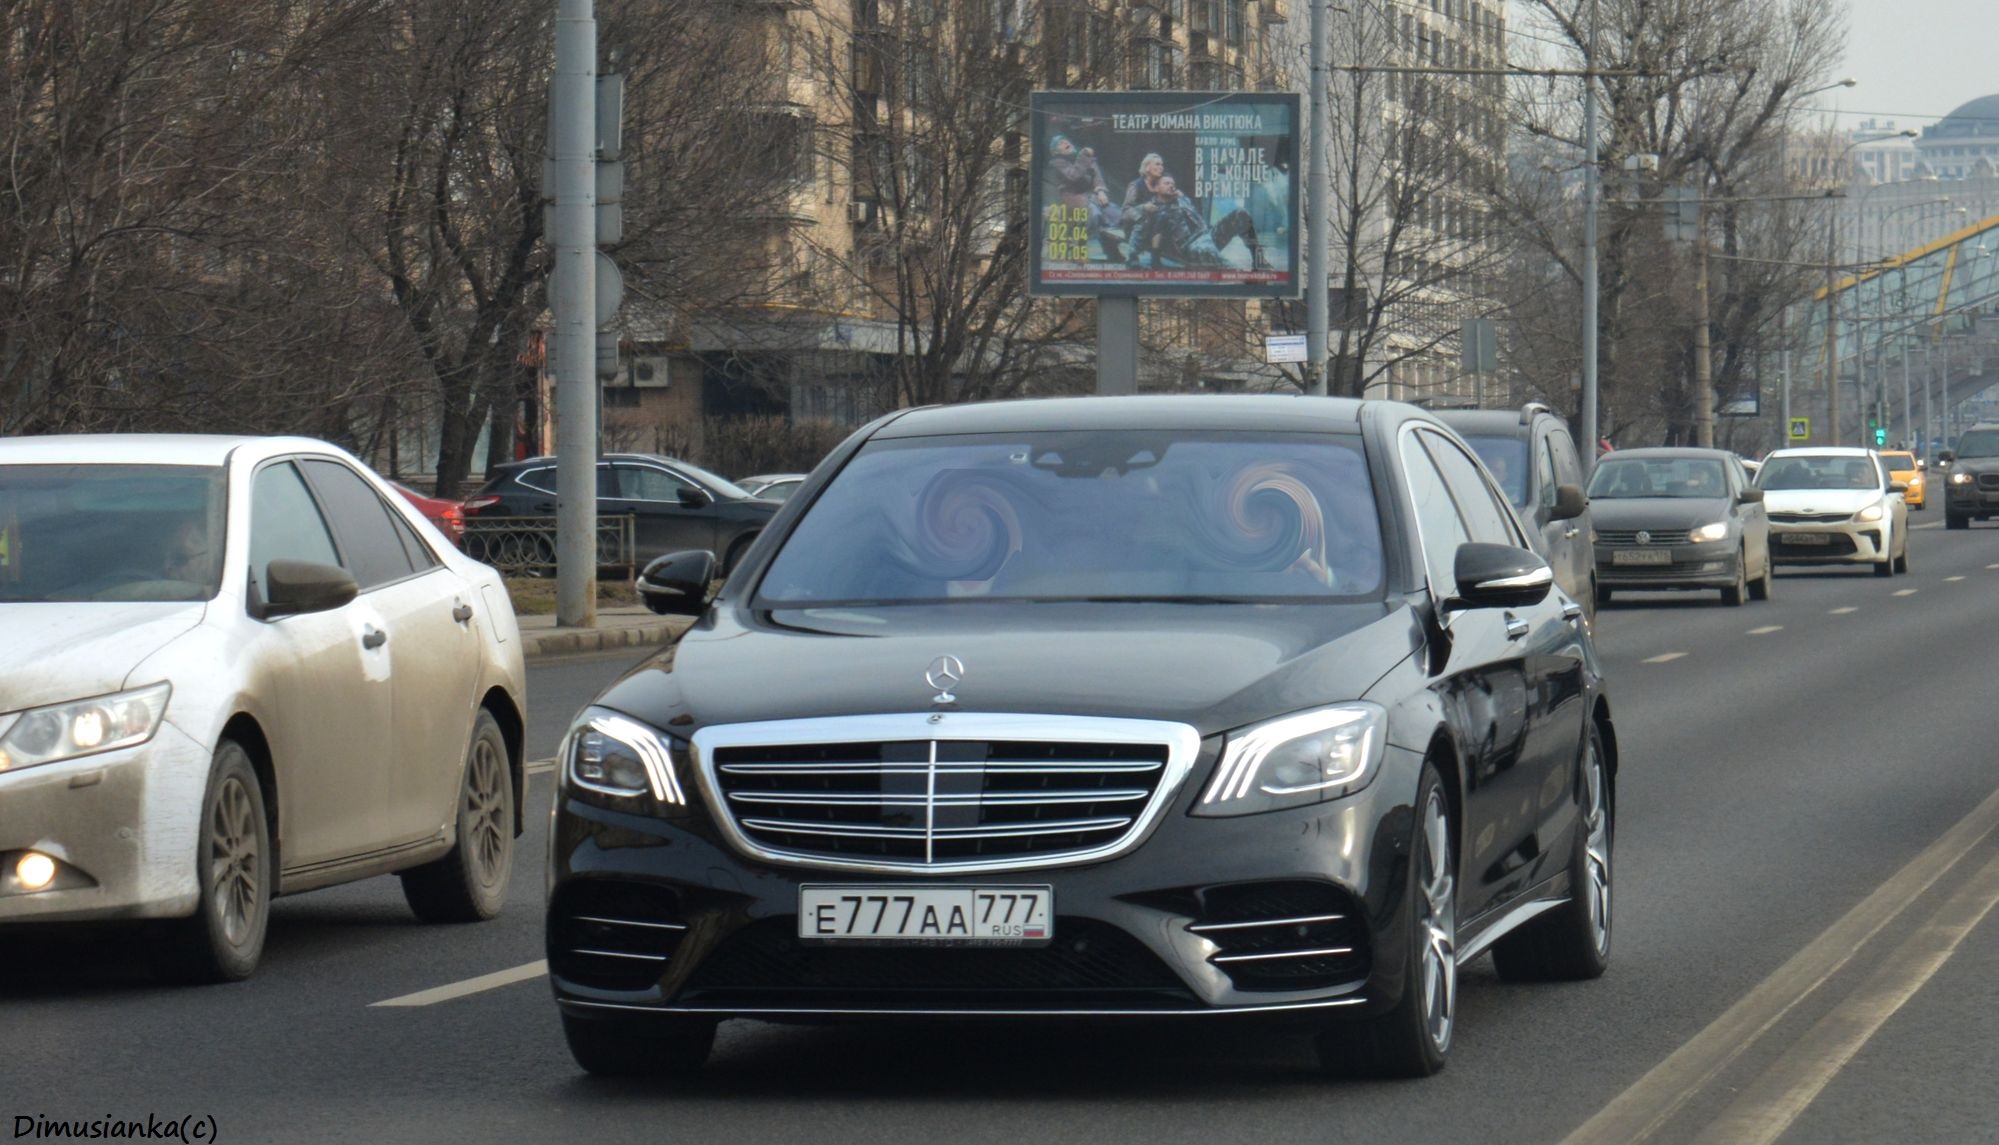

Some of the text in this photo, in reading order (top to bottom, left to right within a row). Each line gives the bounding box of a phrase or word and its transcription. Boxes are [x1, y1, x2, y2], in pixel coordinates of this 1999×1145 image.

[1112, 114, 1262, 130] ТЕАТР РОМАНА ВИКТЮКА
[1195, 147, 1265, 164] В НАЧАЛЕ
[1195, 165, 1269, 183] И В КОНЦЕ
[1195, 181, 1250, 198] ВРЕМЕН
[1049, 204, 1088, 222] 21.03
[1049, 224, 1088, 241] 02.04
[1049, 243, 1088, 260] 09.05
[816, 894, 1038, 934] E777AA 777
[992, 925, 1022, 936] RUS
